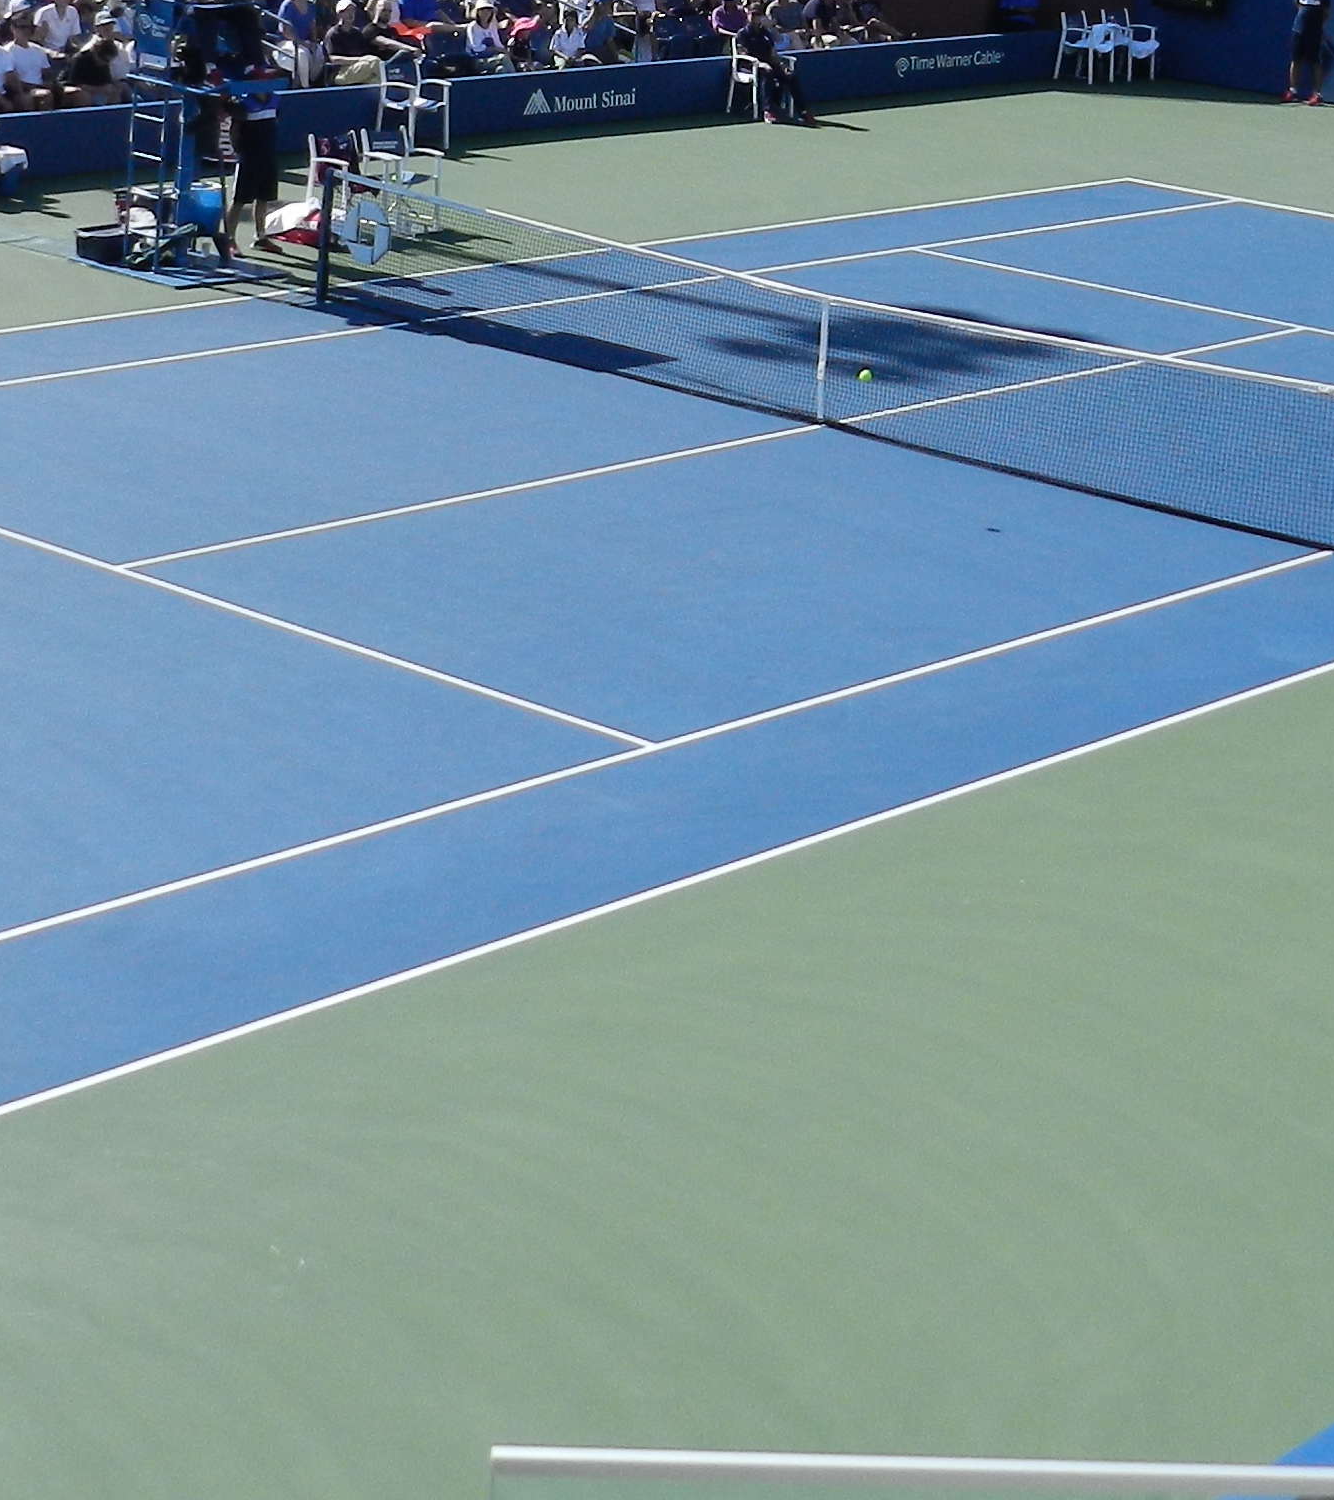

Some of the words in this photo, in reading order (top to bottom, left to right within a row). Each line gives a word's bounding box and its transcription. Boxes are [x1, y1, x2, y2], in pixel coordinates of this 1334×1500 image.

[910, 56, 935, 70] Time
[936, 54, 973, 68] Warner
[974, 50, 1001, 65] Cable
[553, 93, 597, 113] Mount
[601, 87, 636, 108] Sinai
